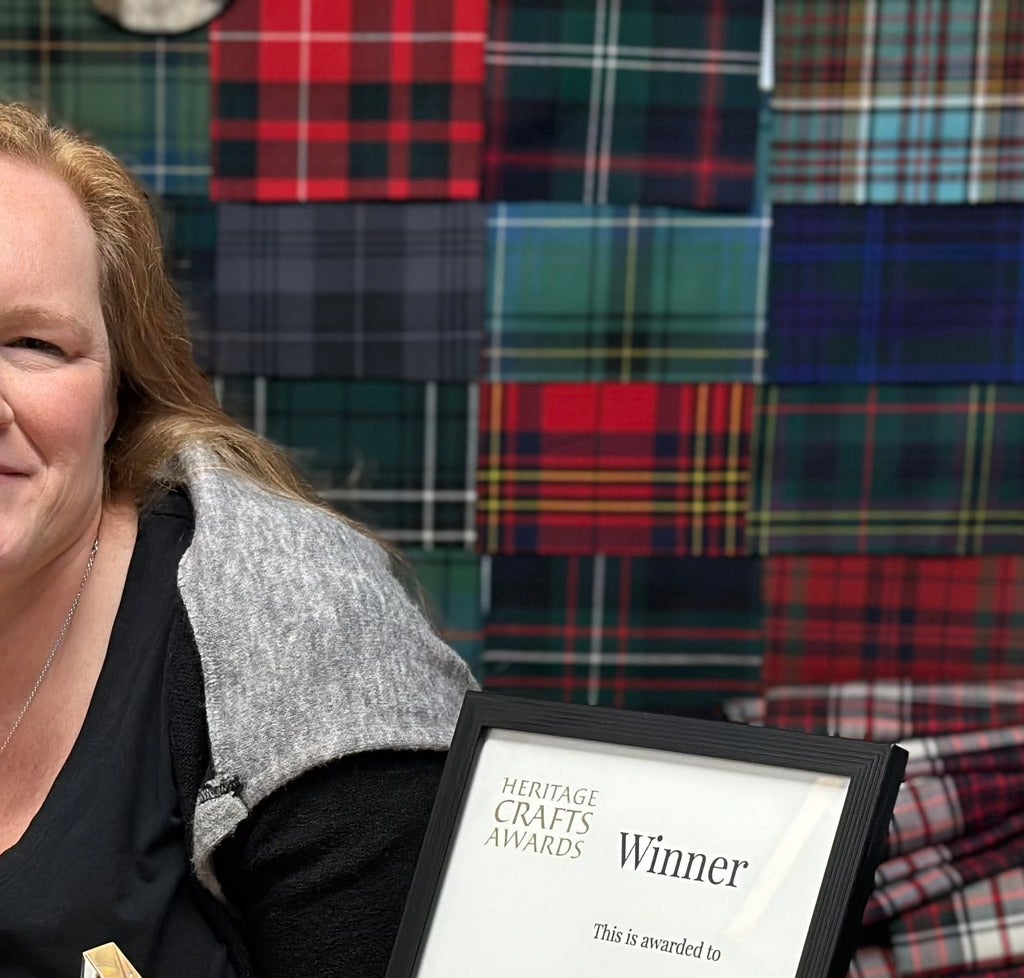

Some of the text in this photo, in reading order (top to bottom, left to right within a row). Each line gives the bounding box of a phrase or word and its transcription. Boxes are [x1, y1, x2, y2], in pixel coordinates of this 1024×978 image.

[502, 777, 599, 807] HERITAGE
[494, 799, 594, 835] CRAFTS
[484, 827, 585, 859] AWARDS
[619, 831, 749, 888] Winner
[593, 923, 721, 962] This is awarded to
